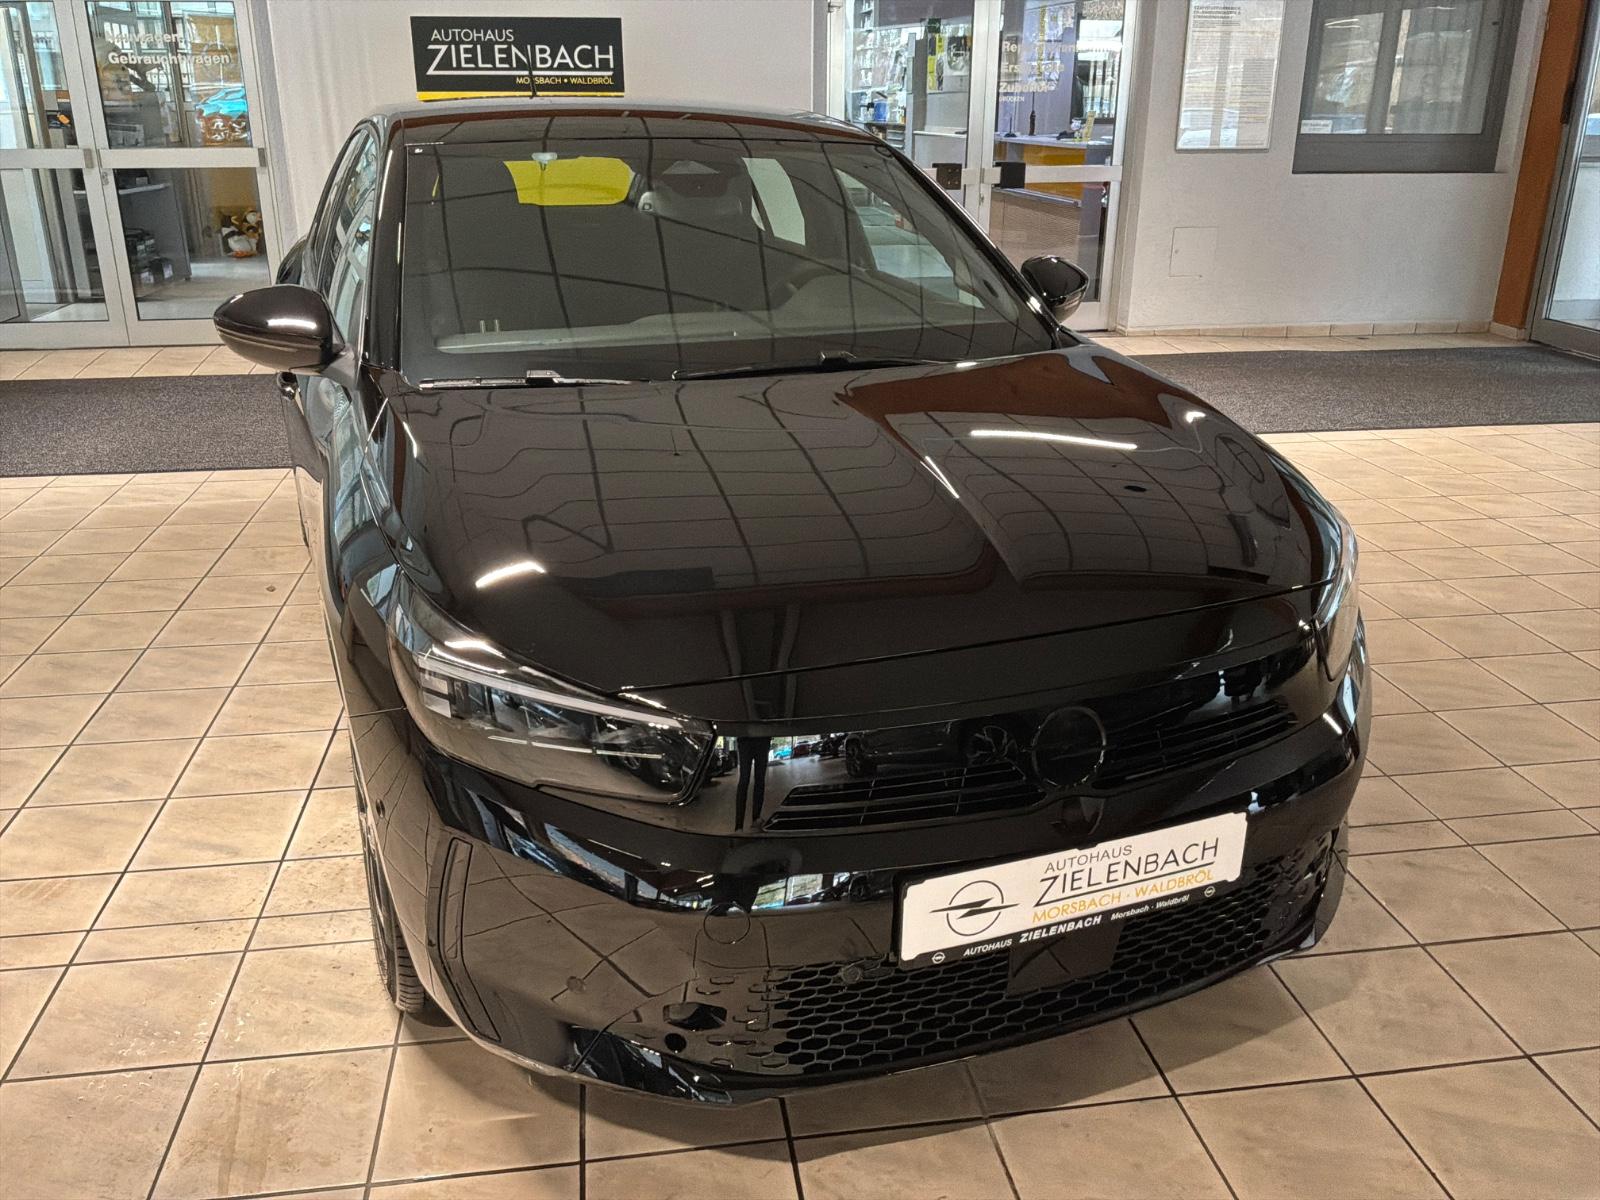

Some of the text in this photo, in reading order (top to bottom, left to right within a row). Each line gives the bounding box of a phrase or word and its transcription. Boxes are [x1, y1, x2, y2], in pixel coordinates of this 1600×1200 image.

[430, 28, 514, 42] AUTOHAUS
[426, 44, 614, 75] ZIELENBACH
[516, 75, 614, 85] MOSBACH WALDBRÖL
[1033, 837, 1219, 907] ZIELENBACH
[1044, 845, 1133, 874] AUTOHAUS
[1032, 868, 1215, 923] MORSBACH WALDBRÖL
[963, 894, 1190, 956] AUTOHAUS ZIELENBACH Morsbach Waldbröl
